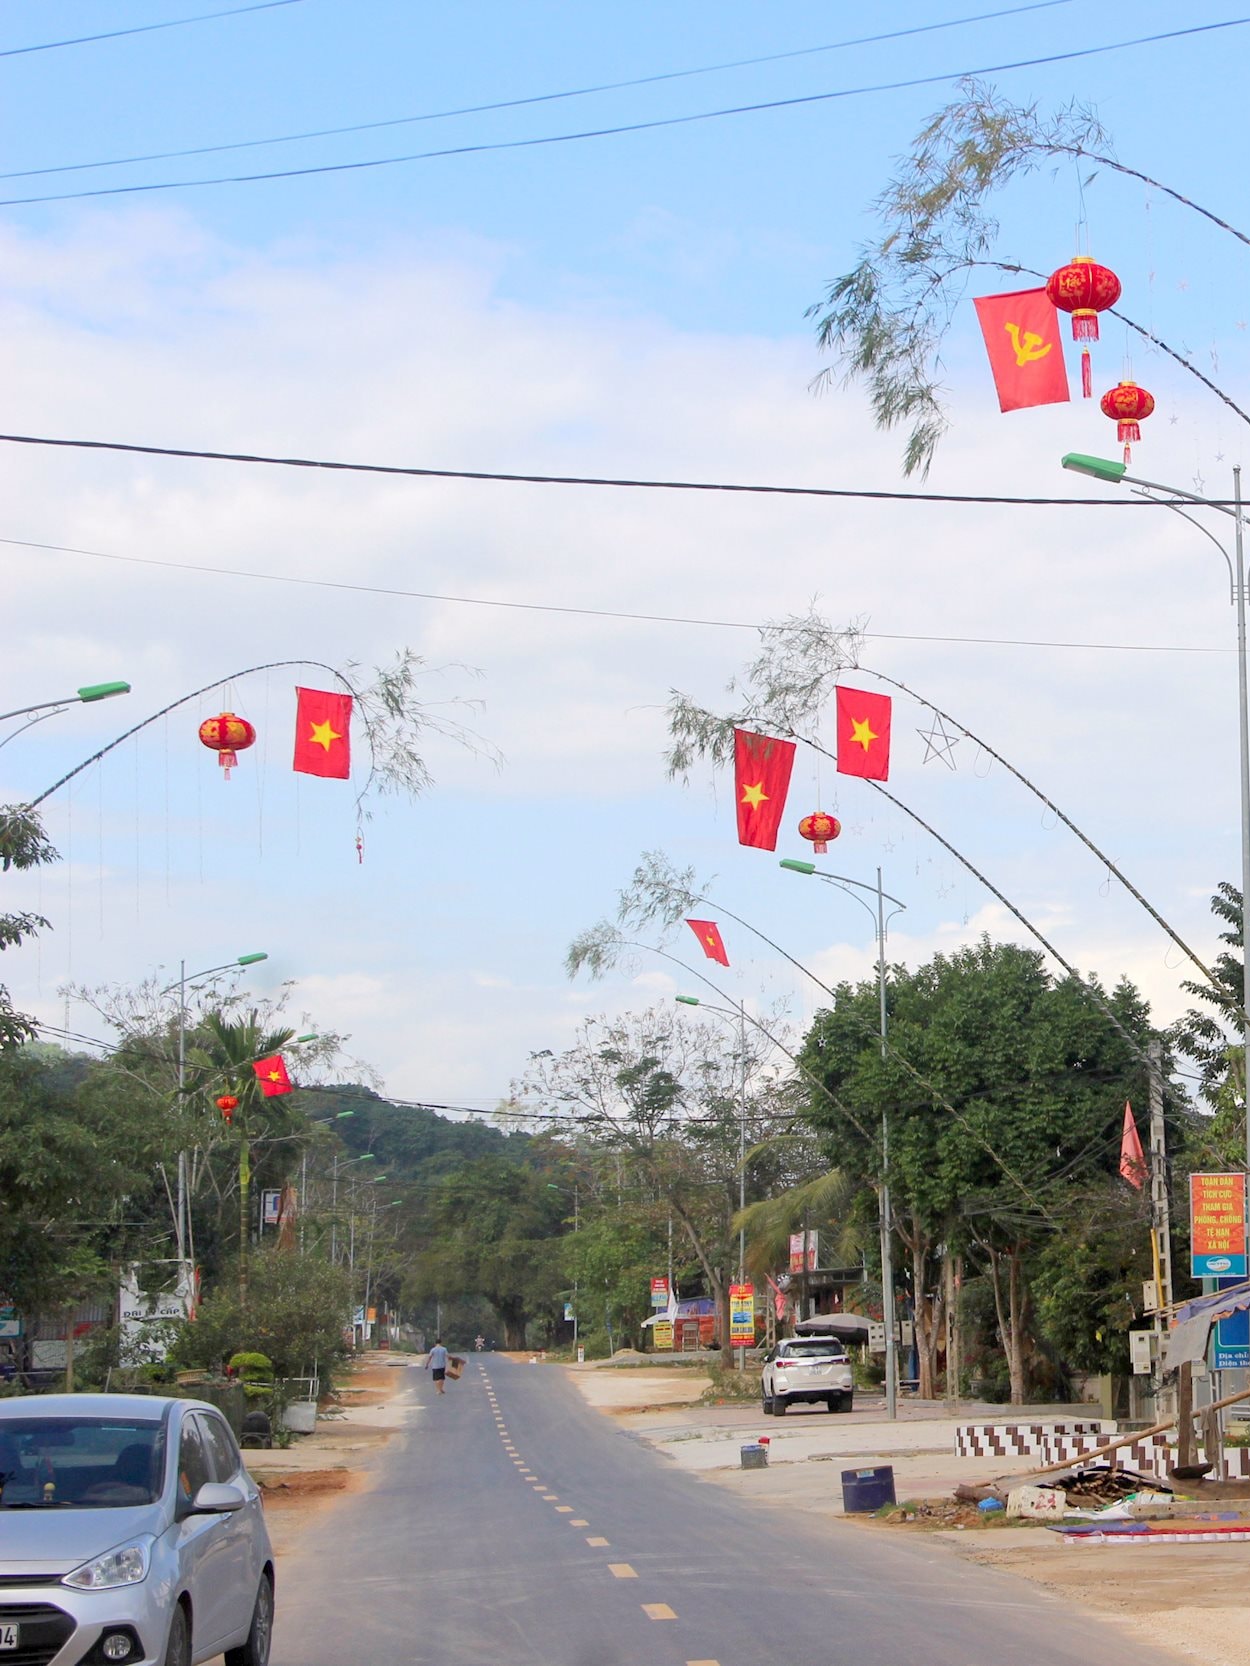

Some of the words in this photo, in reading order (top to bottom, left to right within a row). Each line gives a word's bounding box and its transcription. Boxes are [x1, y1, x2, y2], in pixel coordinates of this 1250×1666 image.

[1202, 1203, 1220, 1211] THAM
[1222, 1203, 1233, 1211] GIA
[0, 1627, 14, 1646] 4
